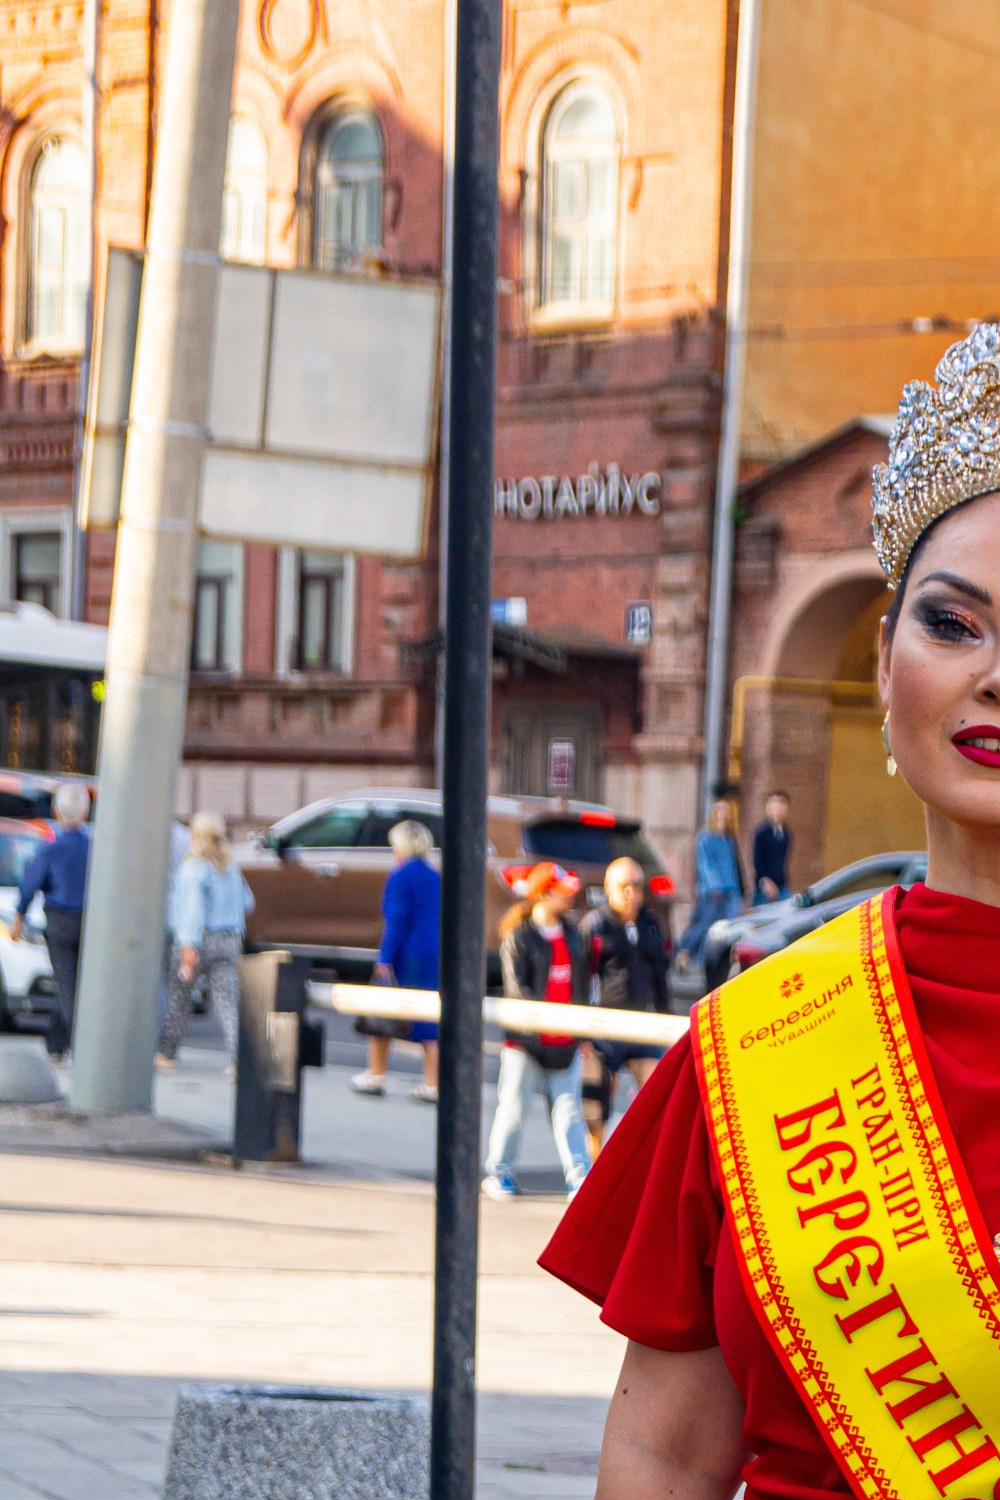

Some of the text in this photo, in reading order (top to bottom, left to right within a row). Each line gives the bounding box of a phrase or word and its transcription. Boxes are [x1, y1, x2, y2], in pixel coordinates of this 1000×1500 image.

[494, 461, 662, 521] НОТАРИУС
[740, 975, 853, 1049] берегиня
[851, 1062, 931, 1251] ГРАН-ПРИ
